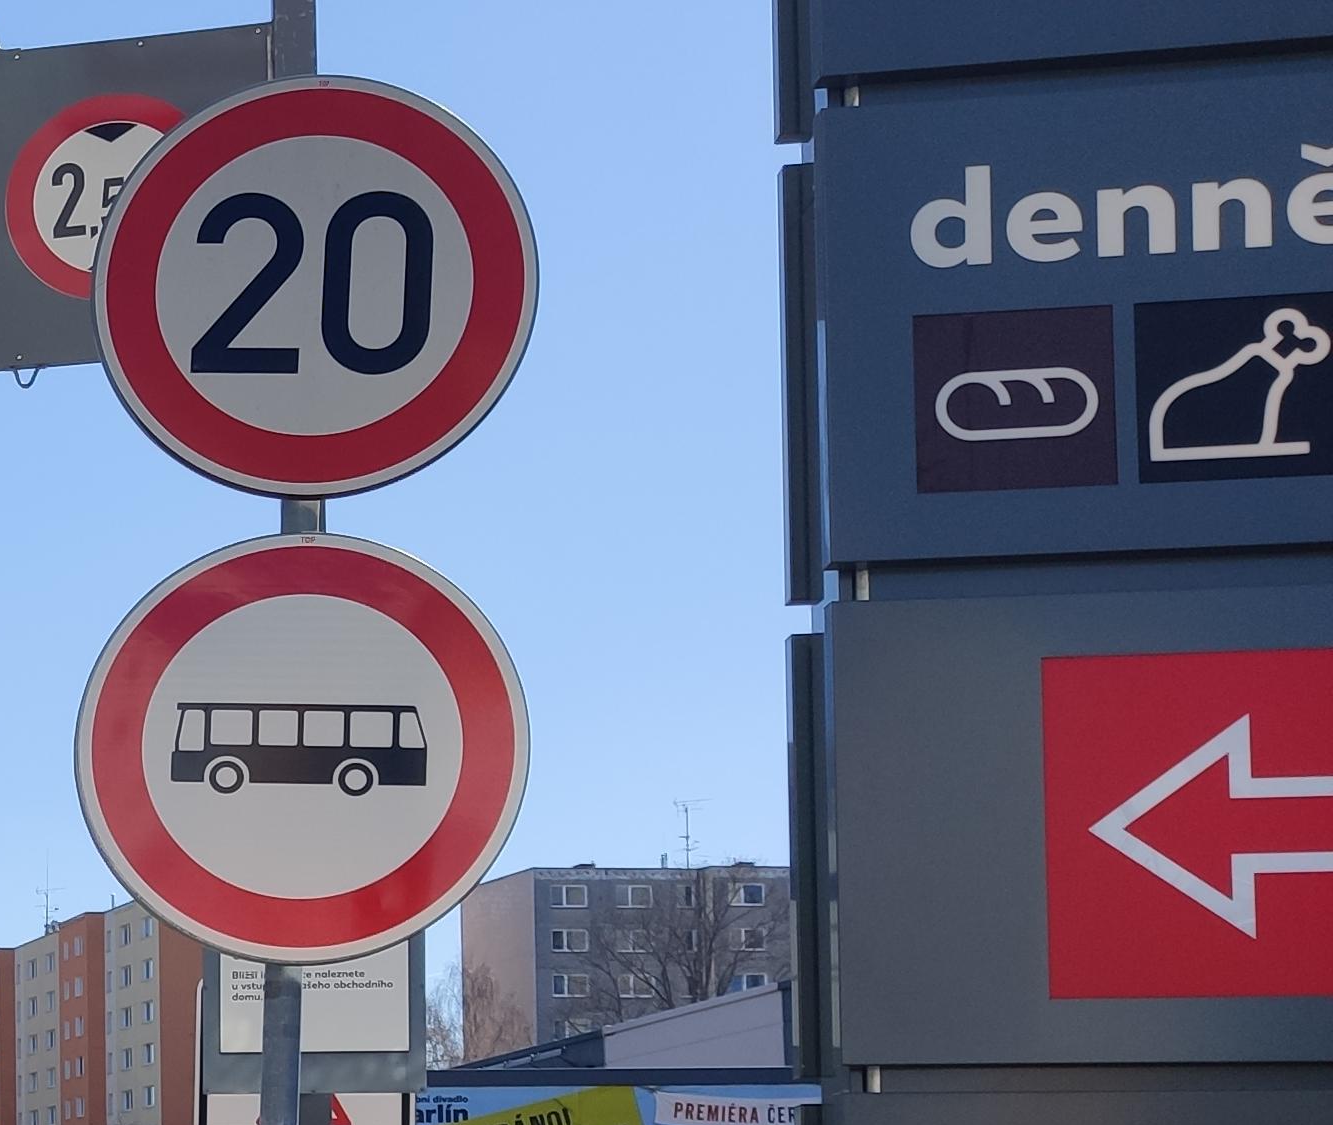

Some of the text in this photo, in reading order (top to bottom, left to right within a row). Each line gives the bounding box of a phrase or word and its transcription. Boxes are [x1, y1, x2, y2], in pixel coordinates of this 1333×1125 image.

[910, 143, 1333, 268] denně
[190, 190, 434, 376] 20
[314, 970, 365, 979] naleznete
[334, 980, 394, 989] obchodního
[232, 992, 263, 1001] domu.
[673, 1102, 760, 1124] PREMIÉRA
